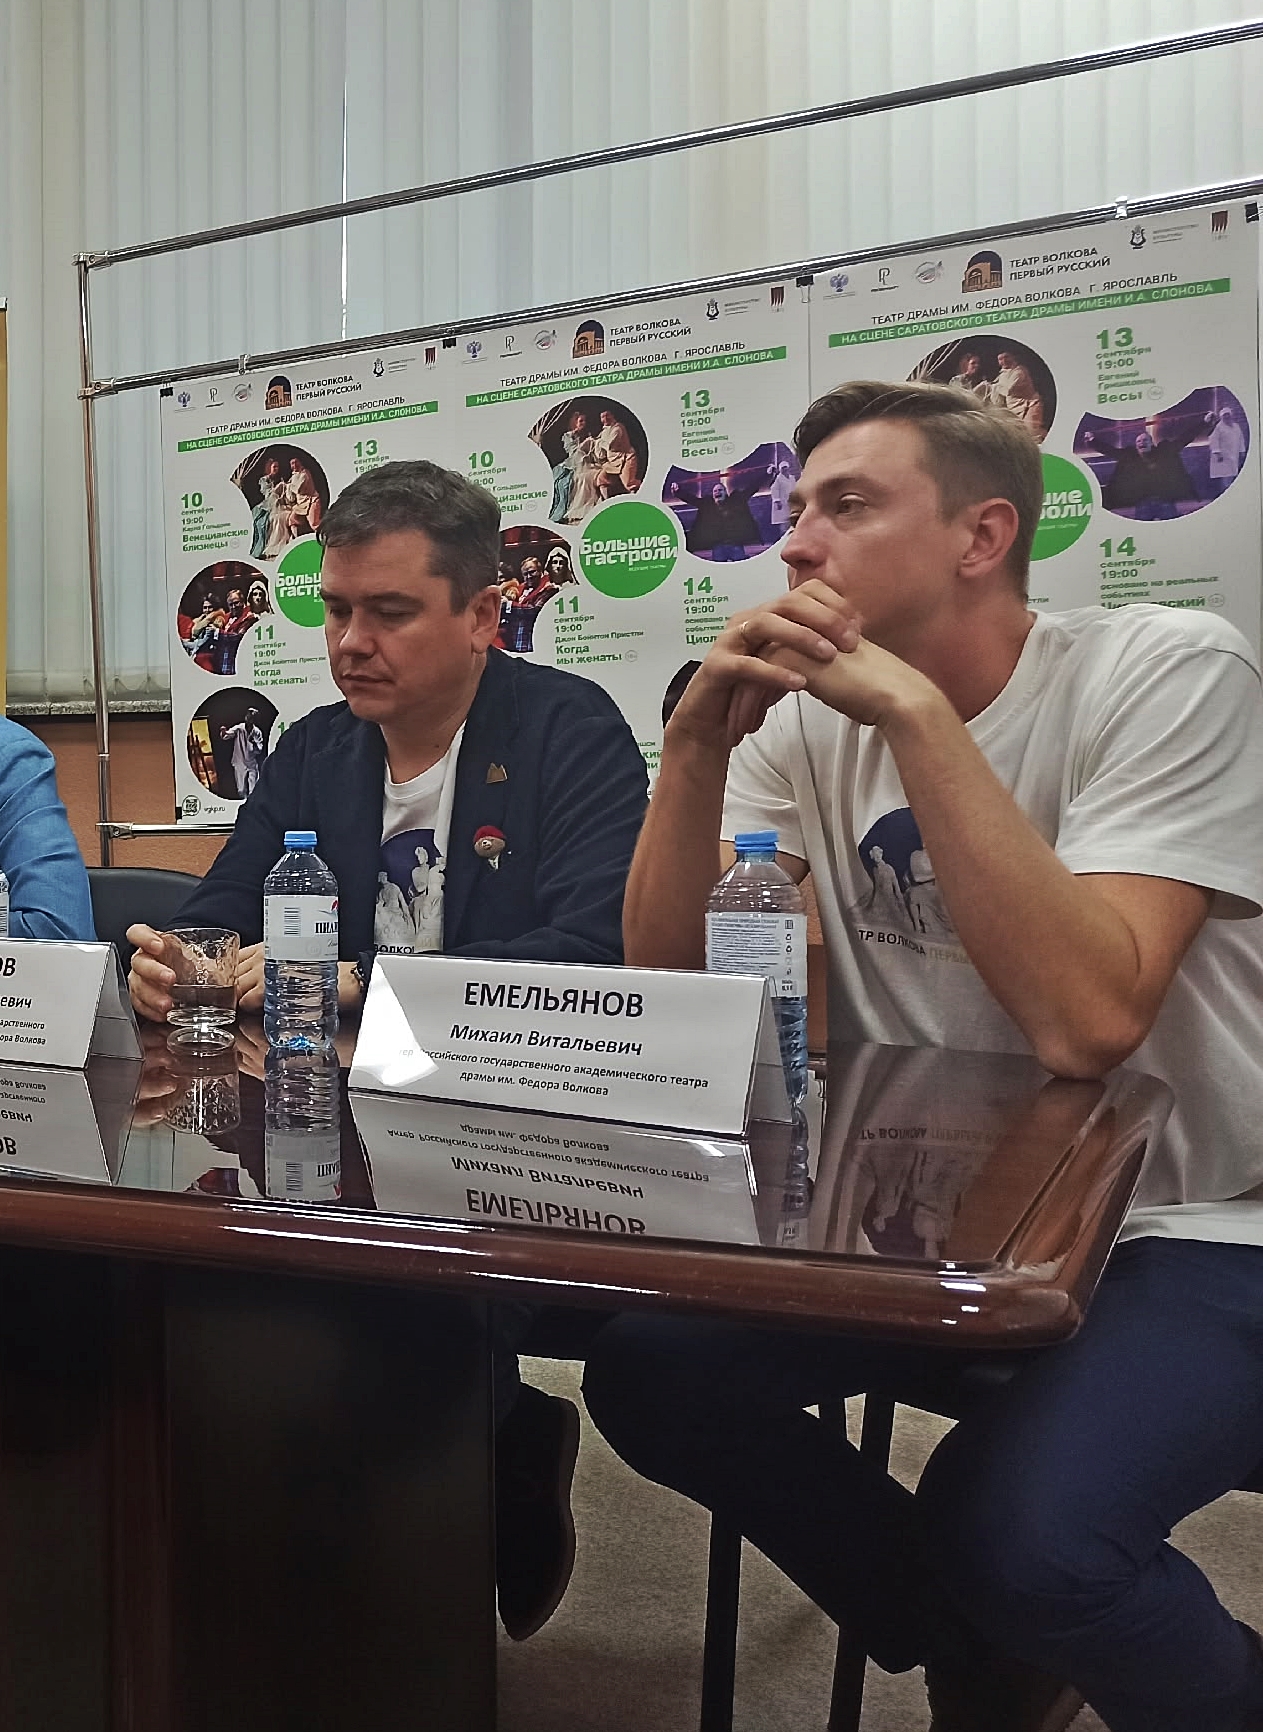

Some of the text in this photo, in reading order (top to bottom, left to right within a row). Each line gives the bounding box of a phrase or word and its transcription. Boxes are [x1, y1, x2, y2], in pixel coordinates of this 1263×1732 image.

[1010, 247, 1098, 269] ТЕАТР ВОЛКОВА
[1009, 256, 1111, 281] ПЕРВЫЙ РУССКИЙ
[871, 272, 1178, 325] ТЕАТР ДРАМЫ ИМ. ФЕДОРА ВОЛКОВА Г. ЯРОСЛАВЛЬ
[841, 333, 857, 346] НА
[858, 328, 895, 343] СЦЕНЕ
[896, 316, 984, 337] САРАТОВСКОГО
[986, 308, 1029, 324] ТЕАТРА
[1030, 302, 1075, 319] ДРАМЫ
[1078, 295, 1123, 311] ИМЕНИ
[1151, 282, 1213, 300] СЛОНОВА
[610, 318, 681, 336] ТЕАТР ВОЛКОВА
[609, 326, 692, 347] ПЕРВЫЙ РУССКИЙ
[1096, 327, 1133, 350] 13
[1096, 346, 1151, 360] сентября
[500, 341, 745, 388] ТЕАТР ДРАМЫ ИМ. ФЕДОРА ВОЛКОВА Г. ЯРОСЛАВЛЬ
[1097, 357, 1134, 370] 19:00
[296, 375, 353, 391] ТЕАТР ВОЛКОВА
[476, 393, 489, 404] НА
[490, 389, 520, 402] СЦЕНЕ
[520, 379, 589, 397] САРАТОВСКОГО
[590, 372, 625, 386] ТЕАТРА
[626, 367, 663, 382] ДРАМЫ
[664, 362, 700, 375] ИМЕНИ
[724, 349, 774, 366] СЛОНОВА
[296, 383, 362, 401] ПЕРВЫЙ РУССКИЙ
[681, 389, 710, 409] 13
[1097, 391, 1143, 404] Весы
[206, 424, 229, 435] ТЕАТР
[230, 420, 257, 432] ДРАМЫ
[274, 412, 306, 425] ФЕДОРА
[306, 406, 343, 420] ВОЛКОВА
[348, 404, 355, 412] Г.
[357, 396, 405, 411] ЯРОСЛАВЛЬ
[681, 406, 725, 418] сентября
[186, 441, 197, 450] НА
[198, 436, 223, 449] СЦЕНЕ
[223, 428, 280, 444] САРАТОВСКОГО
[281, 423, 310, 435] ТЕАТРА
[310, 418, 340, 432] ДРАМЫ
[341, 414, 369, 427] ИМЕНИ
[388, 405, 428, 419] СЛОНОВА
[681, 416, 711, 428] 19:00
[354, 439, 378, 458] 13
[681, 446, 718, 458] Весы
[468, 450, 494, 469] 10
[468, 466, 507, 476] сентября
[181, 492, 203, 508] 10
[181, 516, 204, 525] 19:00
[182, 529, 249, 543] Венецианские
[580, 534, 671, 554] Большие
[182, 541, 228, 552] близнецы
[1099, 536, 1137, 558] 14
[585, 546, 679, 566] гастроли
[1100, 558, 1156, 569] сентября
[1101, 568, 1138, 579] 19:00
[683, 576, 713, 596] 14
[555, 596, 579, 614] 11
[683, 595, 729, 605] сентября
[685, 605, 715, 615] 19:00
[554, 614, 595, 624] сентября
[254, 624, 275, 641] 11
[555, 623, 582, 633] 19:00
[254, 649, 276, 658] 19:00
[556, 645, 590, 655] Когда
[576, 653, 622, 664] женаты
[253, 668, 281, 678] Когда
[254, 676, 308, 687] мы женаты
[463, 981, 644, 1018] ЕМЕЛЬЯНОВ
[15, 1034, 46, 1046] Волкова
[449, 1023, 644, 1056] Михаил Витальевич
[479, 1056, 572, 1074] государственного
[573, 1063, 667, 1084] академического
[669, 1074, 709, 1089] театра
[459, 1070, 609, 1096] драмы им. Федора Волкова
